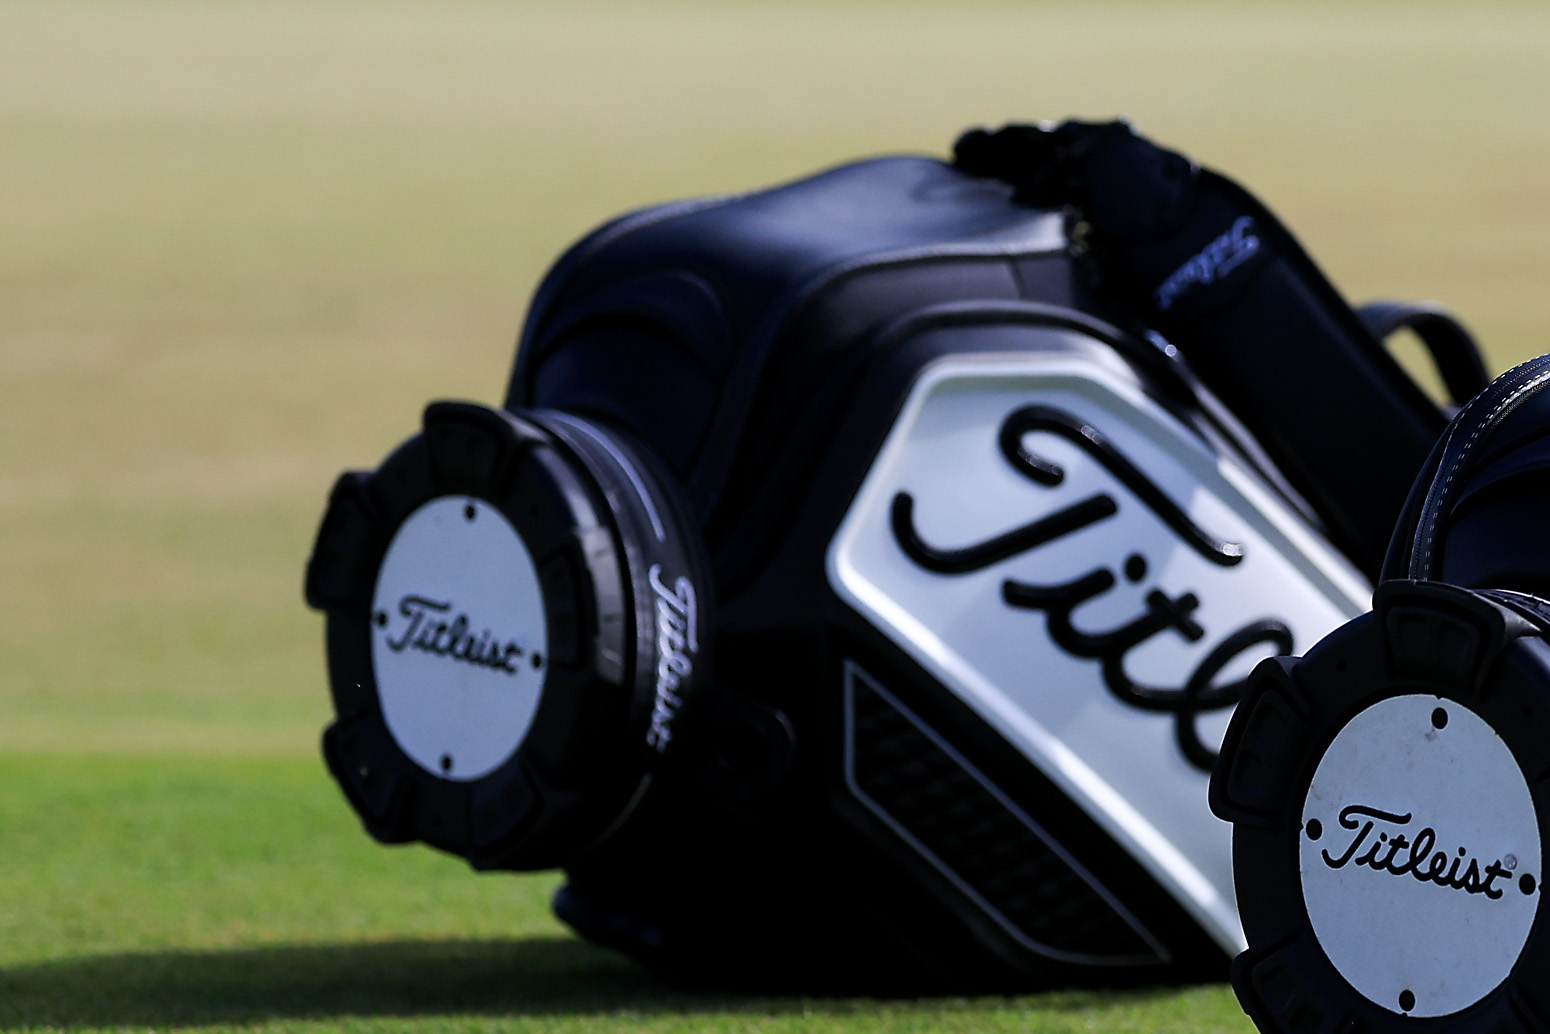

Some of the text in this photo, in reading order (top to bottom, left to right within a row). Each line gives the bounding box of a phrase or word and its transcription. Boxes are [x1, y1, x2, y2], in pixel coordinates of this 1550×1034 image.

[387, 593, 525, 676] Titleist
[889, 404, 1294, 773] Titl
[1321, 804, 1513, 900] Titleist
